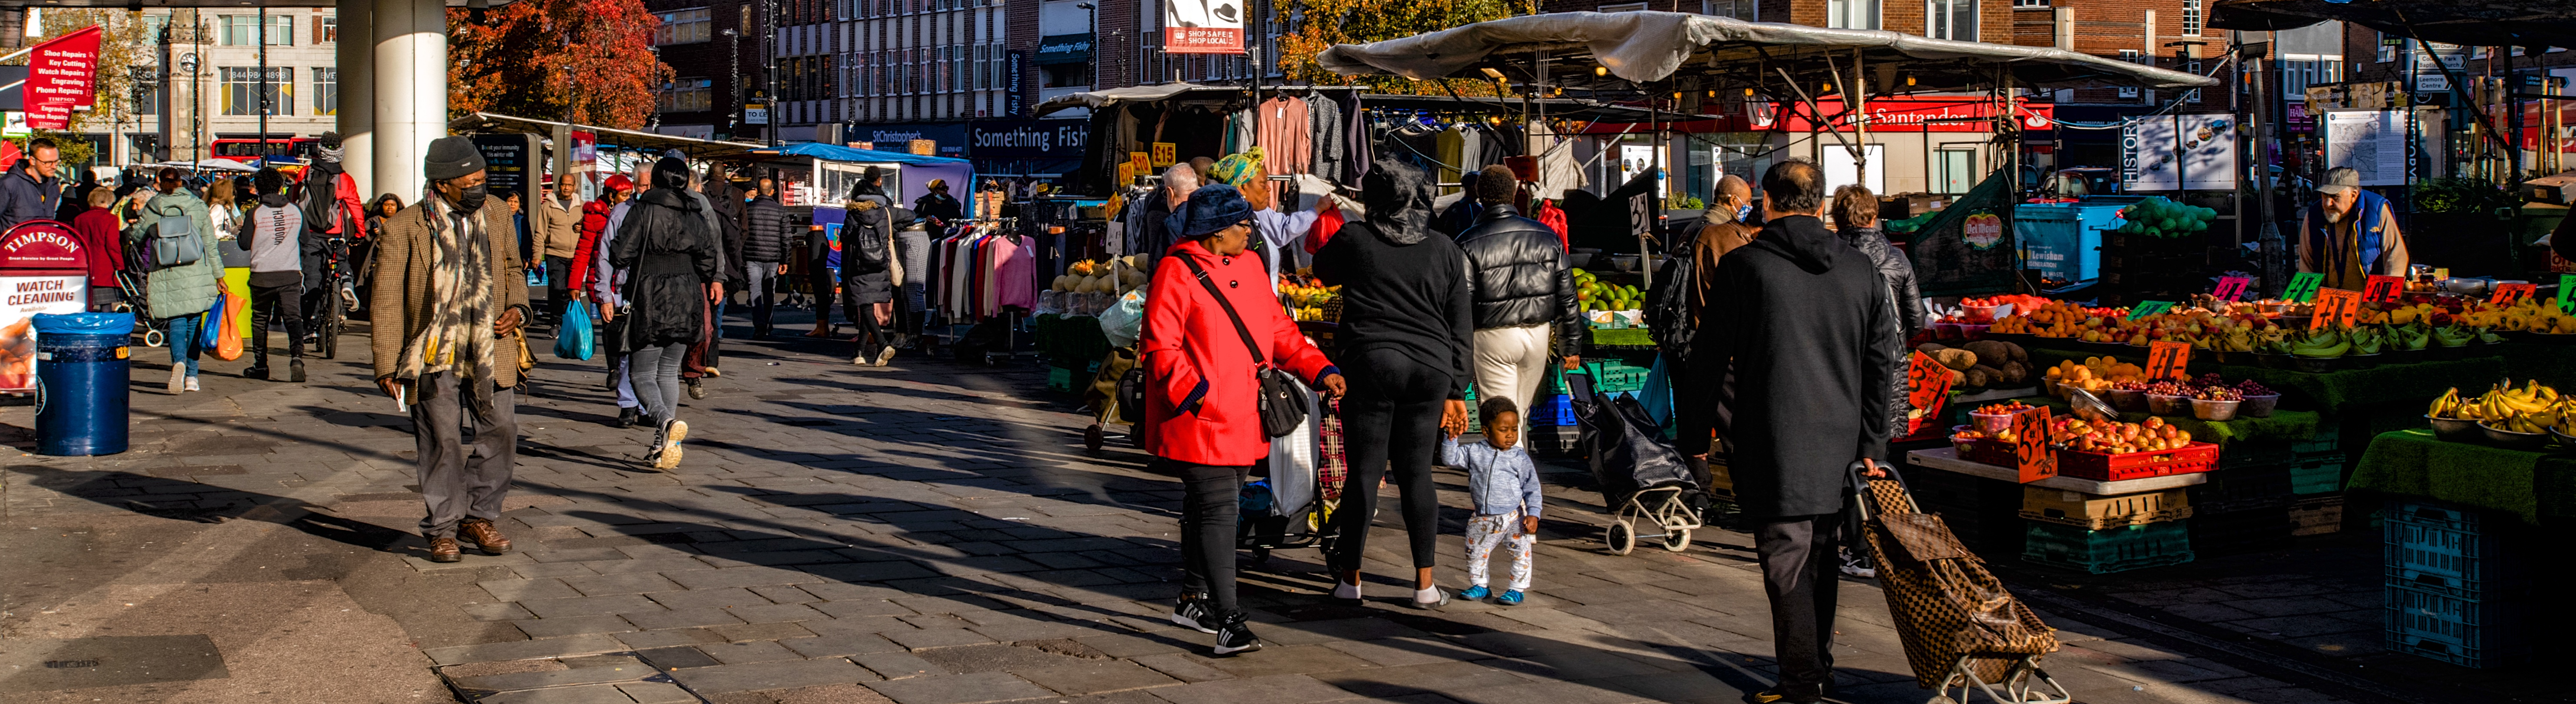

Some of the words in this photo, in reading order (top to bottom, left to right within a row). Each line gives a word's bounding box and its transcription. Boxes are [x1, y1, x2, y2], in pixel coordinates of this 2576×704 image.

[1040, 43, 1073, 54] Something
[1073, 41, 1090, 52] Fishy
[63, 60, 86, 68] Cutting
[1009, 53, 1020, 92] Something
[51, 78, 84, 87] Engraving
[1009, 95, 1020, 115] Fishy
[1875, 107, 1968, 127] Santander
[581, 140, 593, 155] Tired
[975, 127, 1050, 152] Something
[1059, 125, 1088, 147] Fish
[1155, 146, 1173, 163] £15
[2124, 117, 2137, 182] HISTORY
[1132, 155, 1148, 171] £10
[1120, 165, 1132, 183] £10
[1107, 197, 1117, 215] £5
[1967, 224, 1978, 234] Del
[1978, 223, 2000, 234] Monte
[4, 232, 80, 253] TIMPSON
[2032, 250, 2064, 261] Lewisham
[16, 279, 64, 293] WATCH
[8, 292, 75, 306] CLEANING
[1922, 358, 1946, 378] ONLY
[1909, 365, 1926, 393] 3
[2021, 409, 2041, 430] ONLY
[2019, 427, 2032, 465] 5
